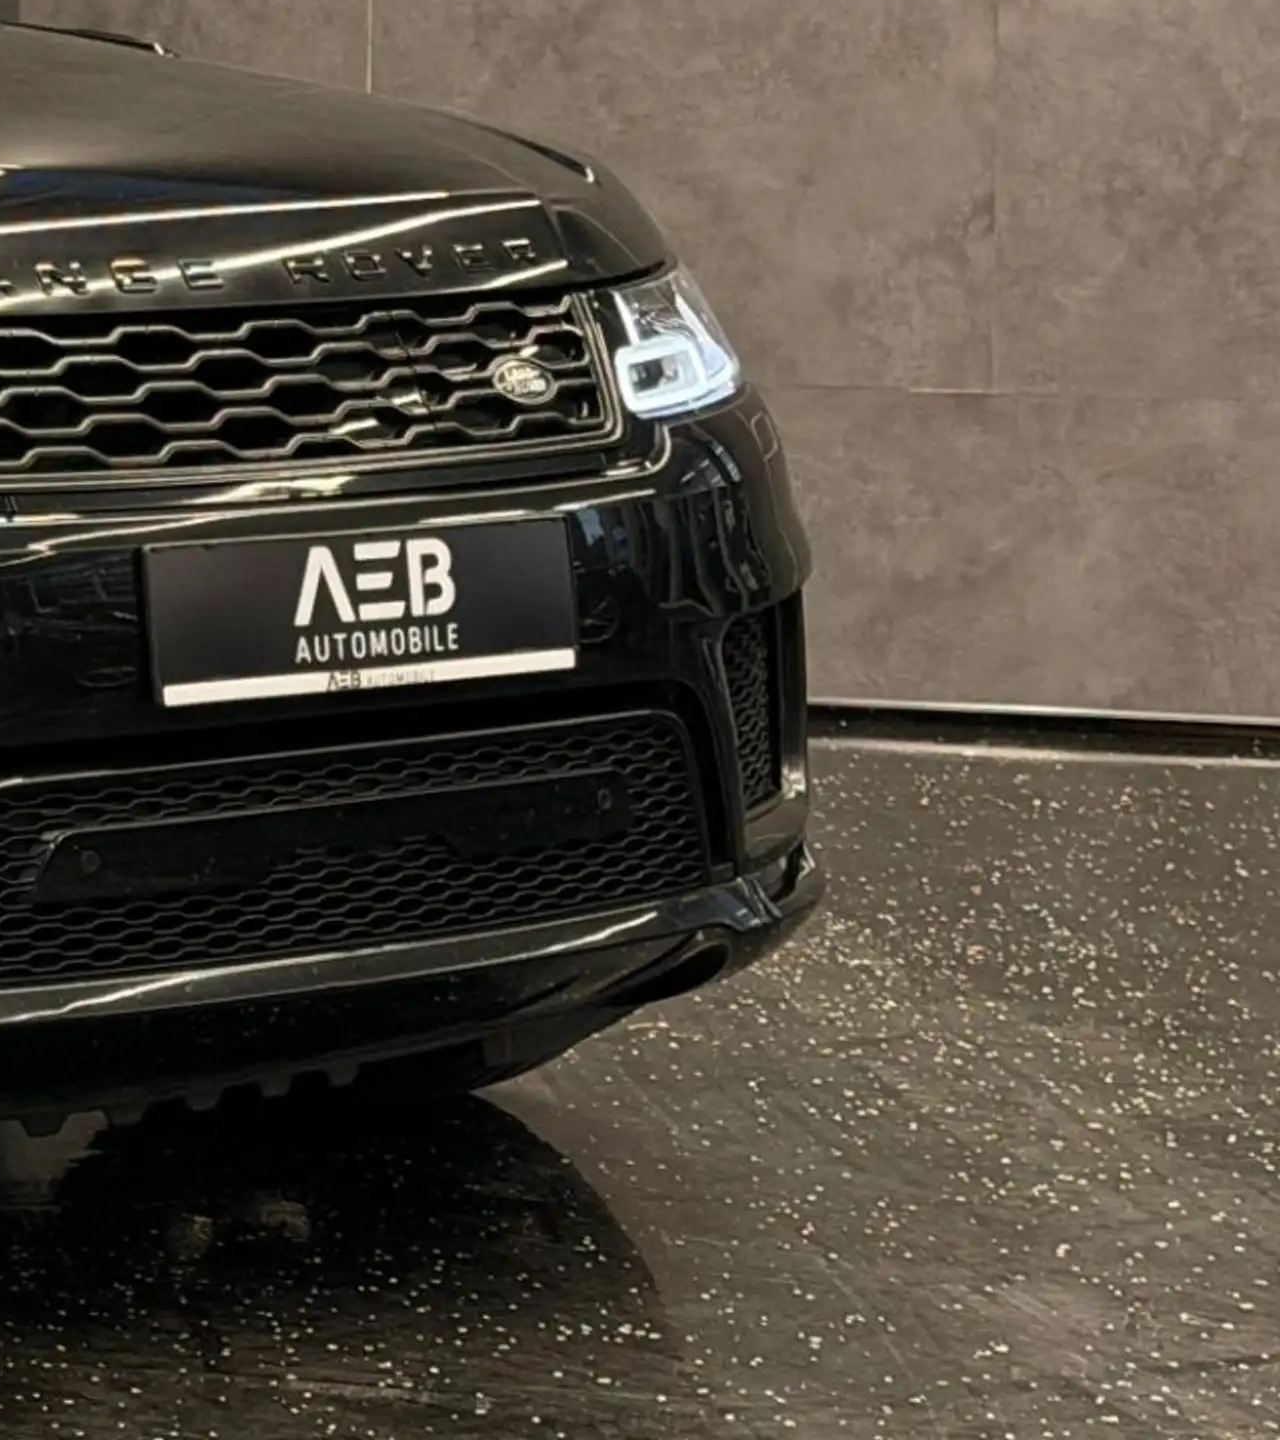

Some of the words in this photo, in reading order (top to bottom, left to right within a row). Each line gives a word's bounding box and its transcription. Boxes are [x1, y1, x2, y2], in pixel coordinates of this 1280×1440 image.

[283, 238, 537, 284] ROVER
[294, 537, 456, 627] AEB
[295, 622, 460, 664] AUTOMOBILE
